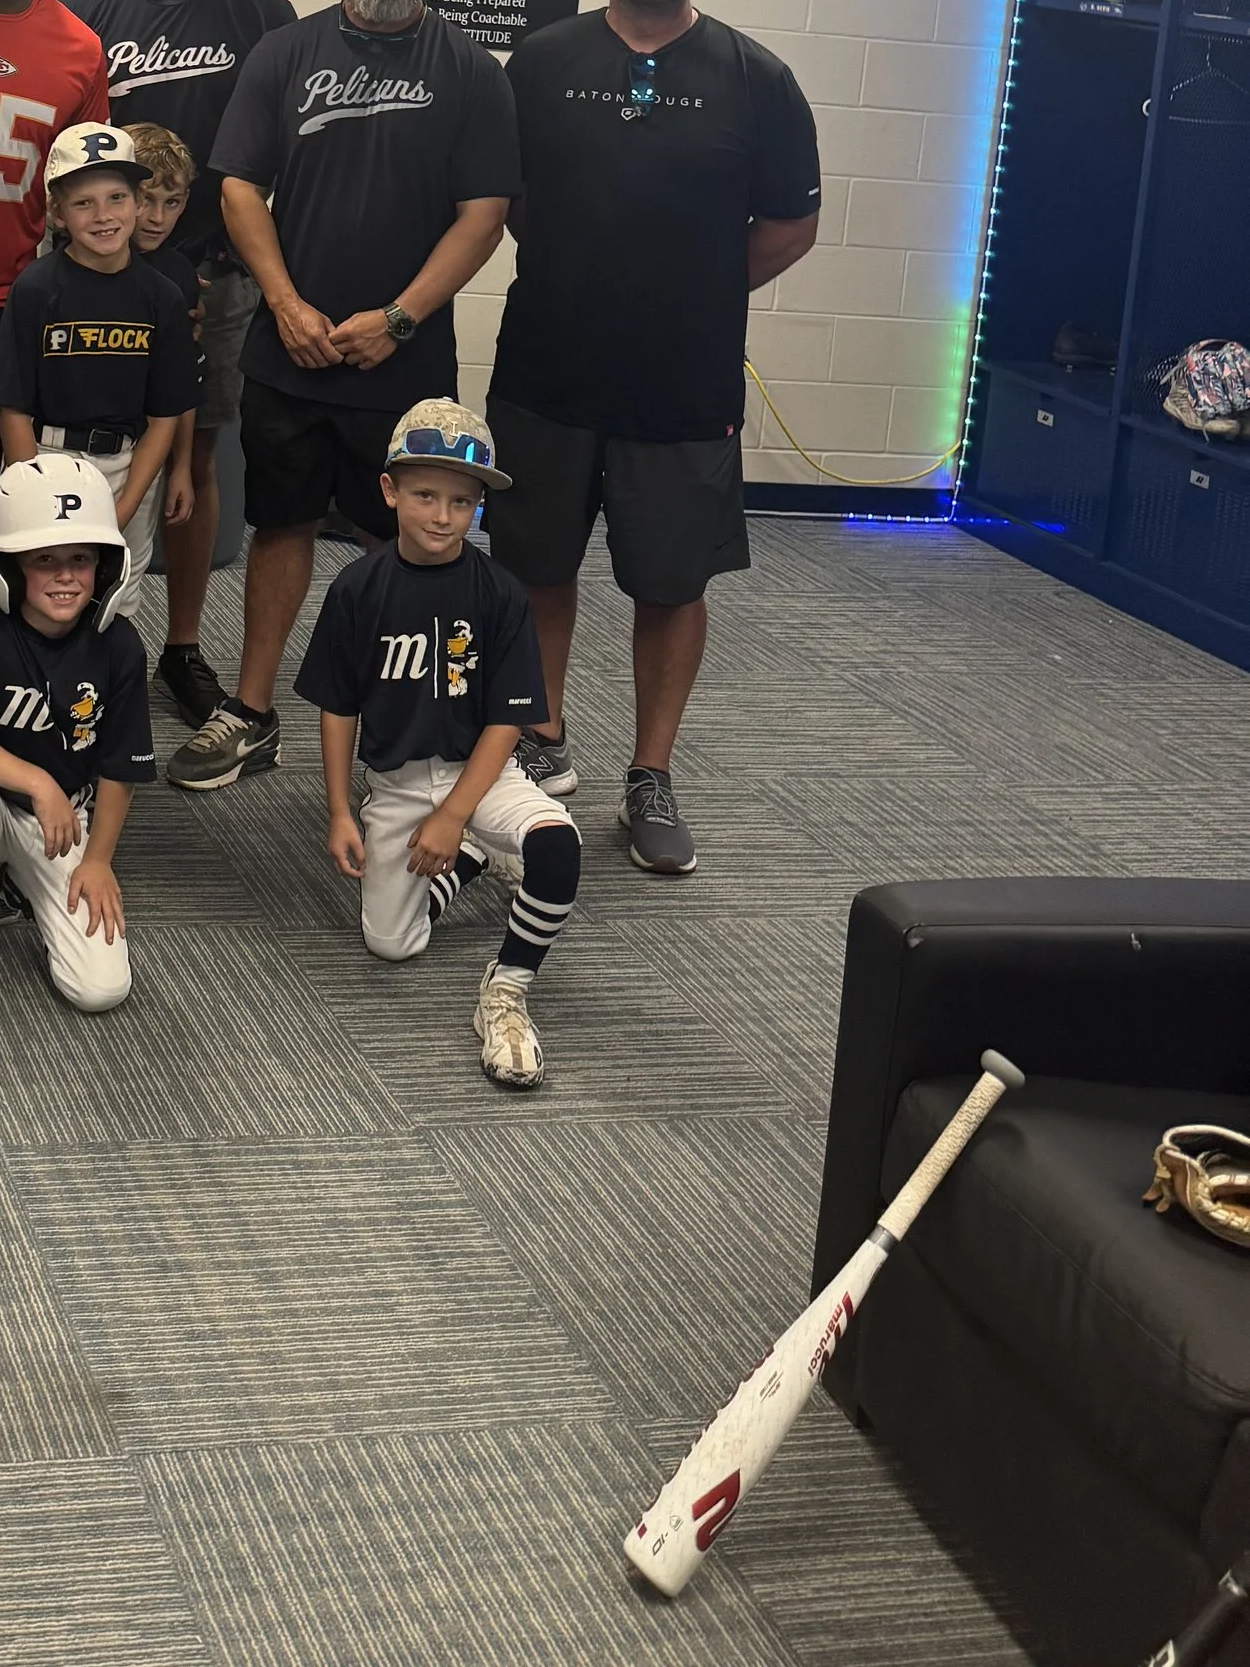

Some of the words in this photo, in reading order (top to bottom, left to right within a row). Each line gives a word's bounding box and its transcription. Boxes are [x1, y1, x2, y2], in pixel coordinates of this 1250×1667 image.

[439, 8, 469, 26] Being
[471, 10, 528, 27] Coachable
[462, 28, 512, 44] TITUDE
[107, 35, 236, 77] Pelicans
[300, 65, 434, 113] Pelicans
[565, 89, 625, 103] BATON
[79, 132, 118, 165] P
[50, 329, 68, 351] P
[77, 327, 150, 350] FLOCK
[53, 493, 82, 520] P
[379, 633, 429, 680] m
[808, 1302, 844, 1377] marucci
